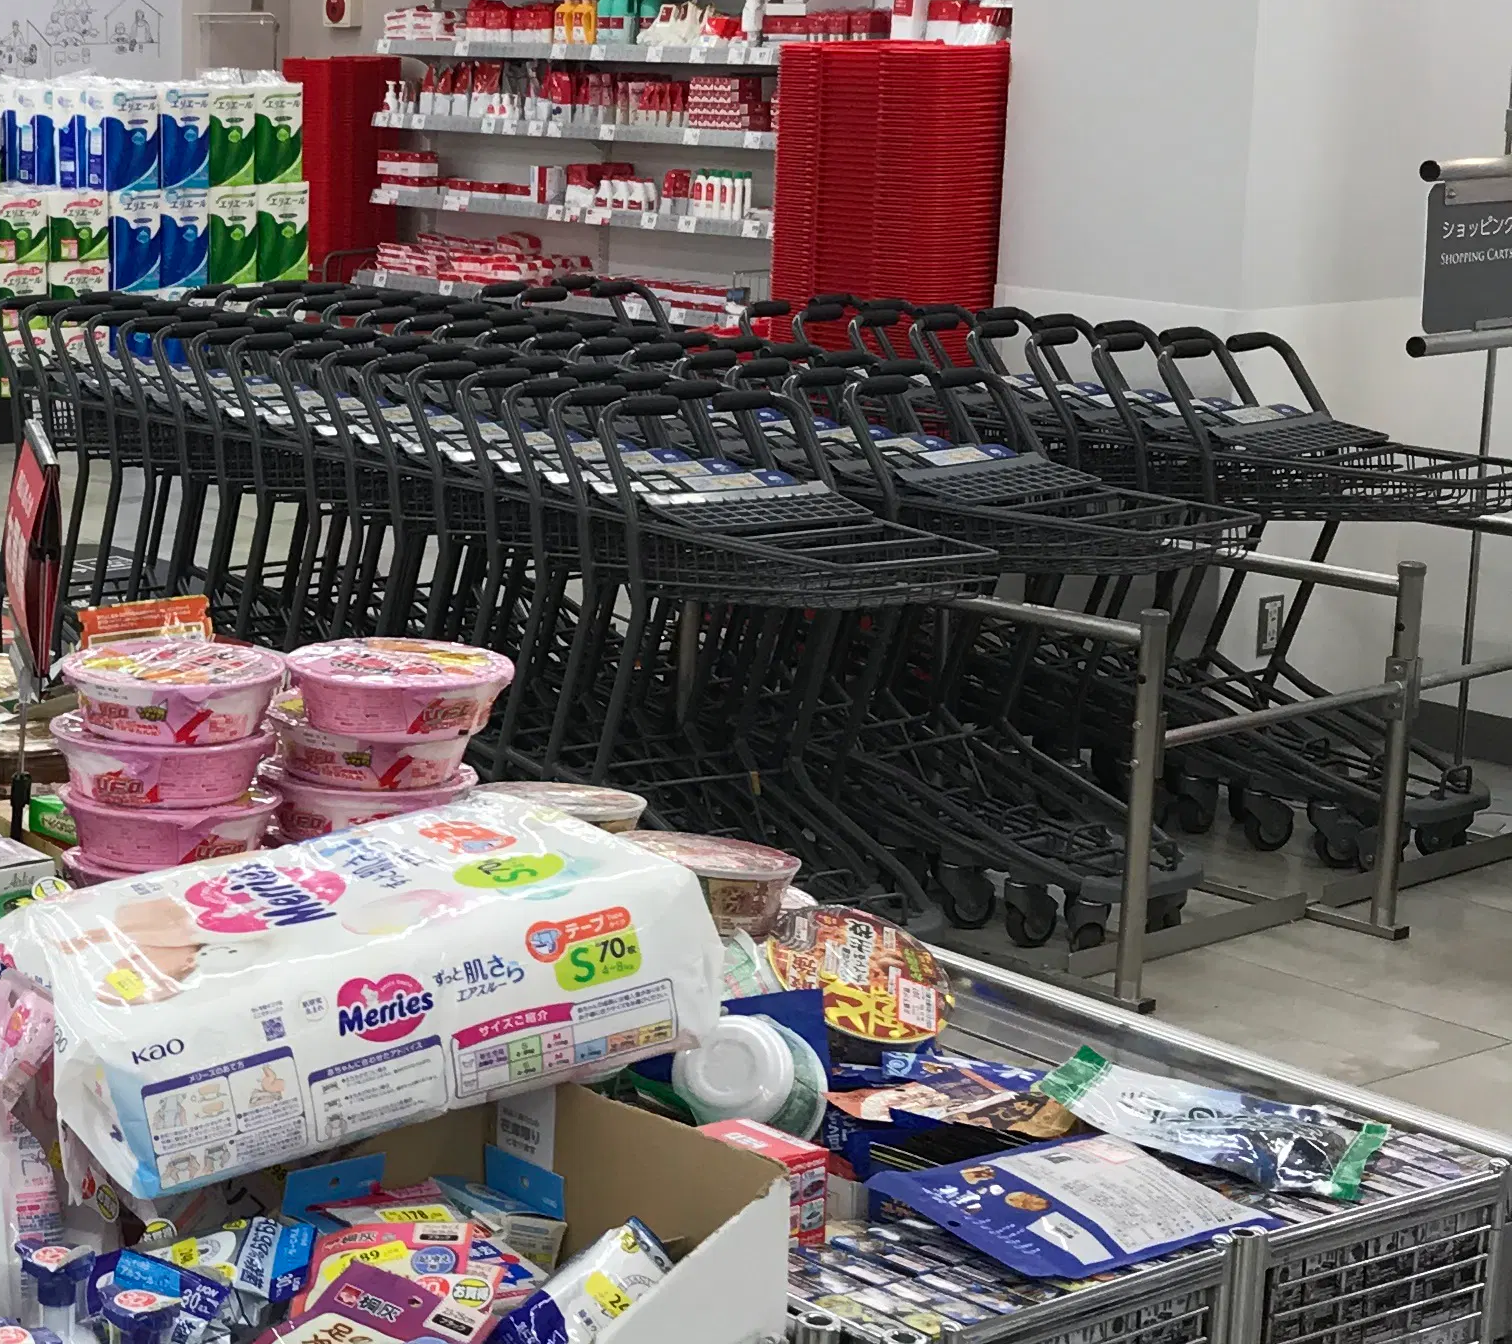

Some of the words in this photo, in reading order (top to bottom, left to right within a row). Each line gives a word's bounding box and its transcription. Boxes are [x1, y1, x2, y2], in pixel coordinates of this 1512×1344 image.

[565, 914, 605, 940] テープ
[570, 946, 596, 984] S
[338, 991, 434, 1037] Merries
